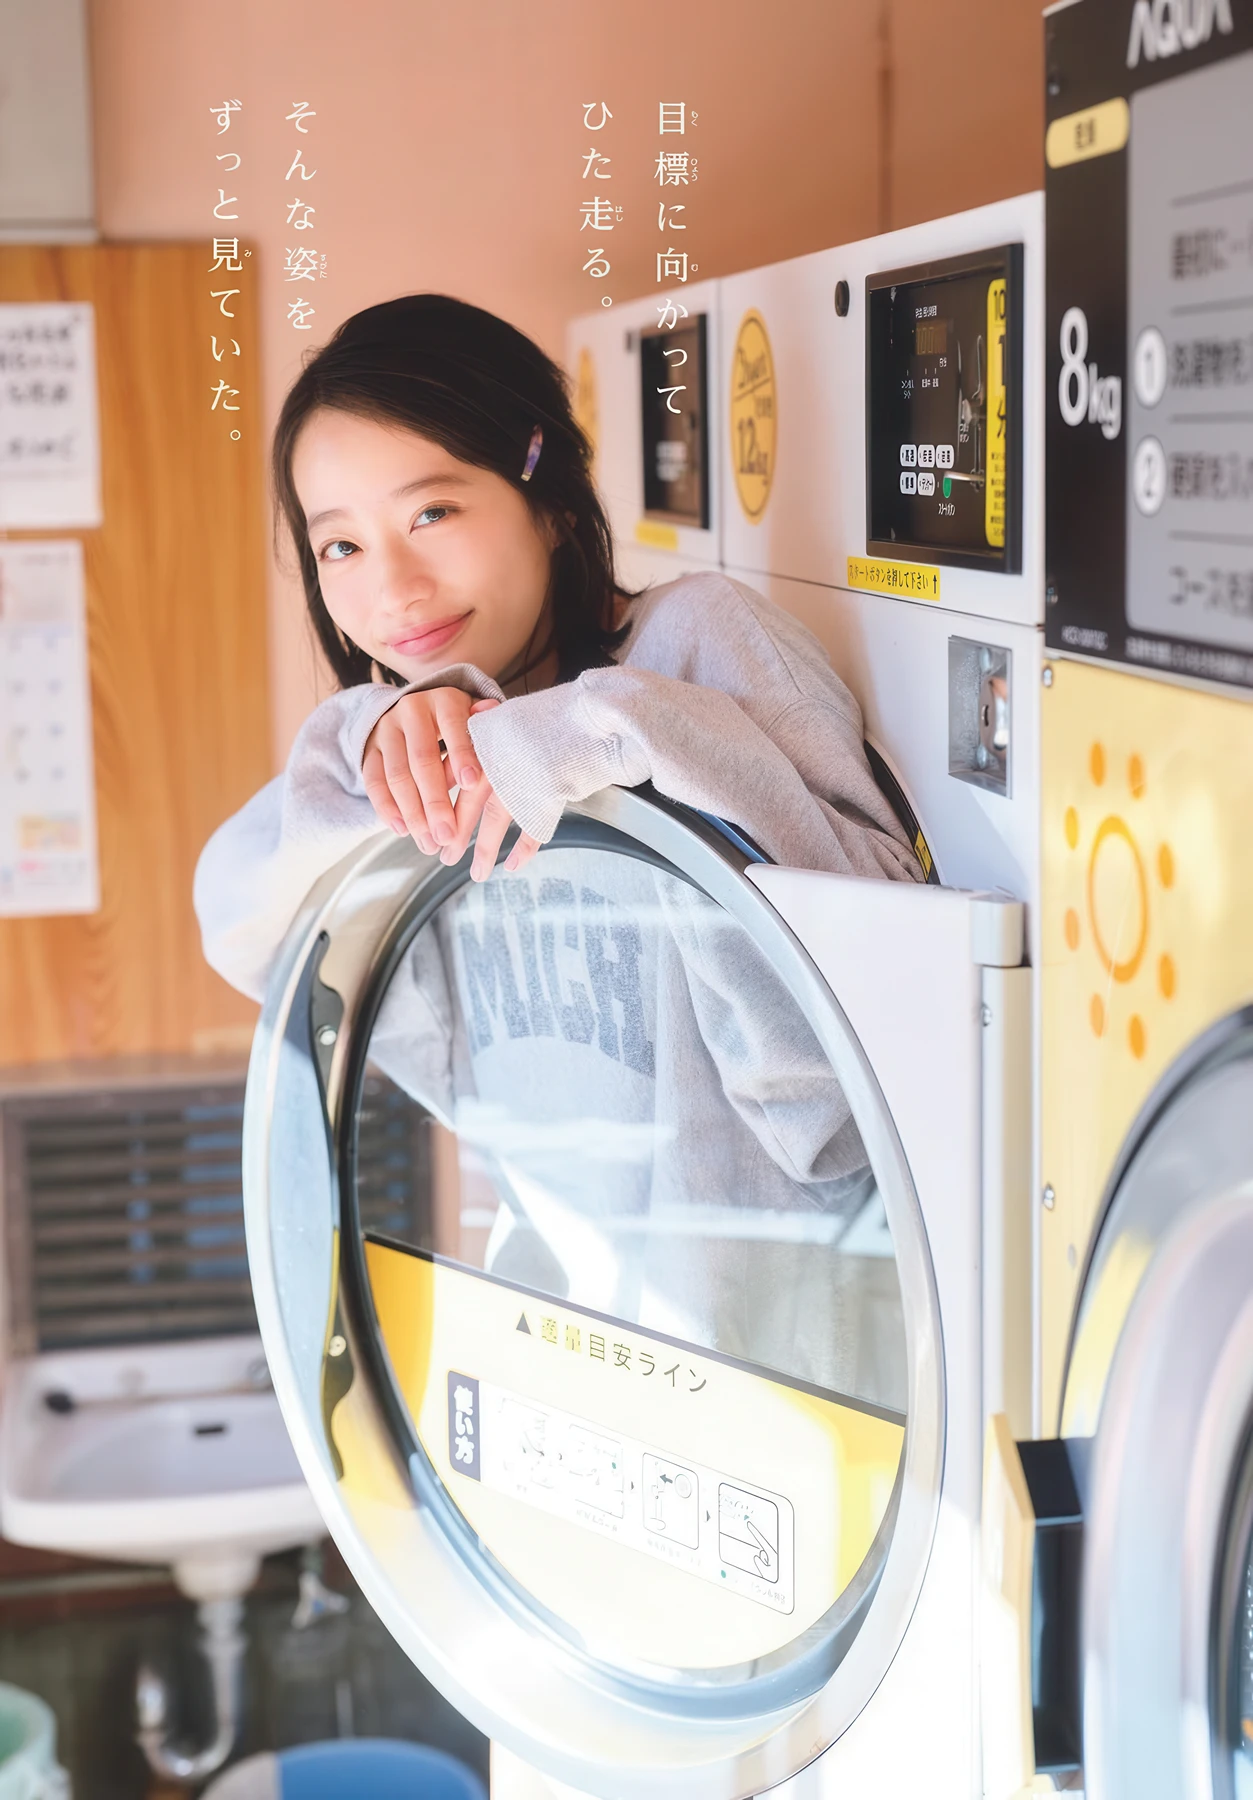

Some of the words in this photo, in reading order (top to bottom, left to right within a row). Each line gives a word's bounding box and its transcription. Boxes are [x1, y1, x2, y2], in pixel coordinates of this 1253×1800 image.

[541, 1315, 707, 1392] 目安ライン
